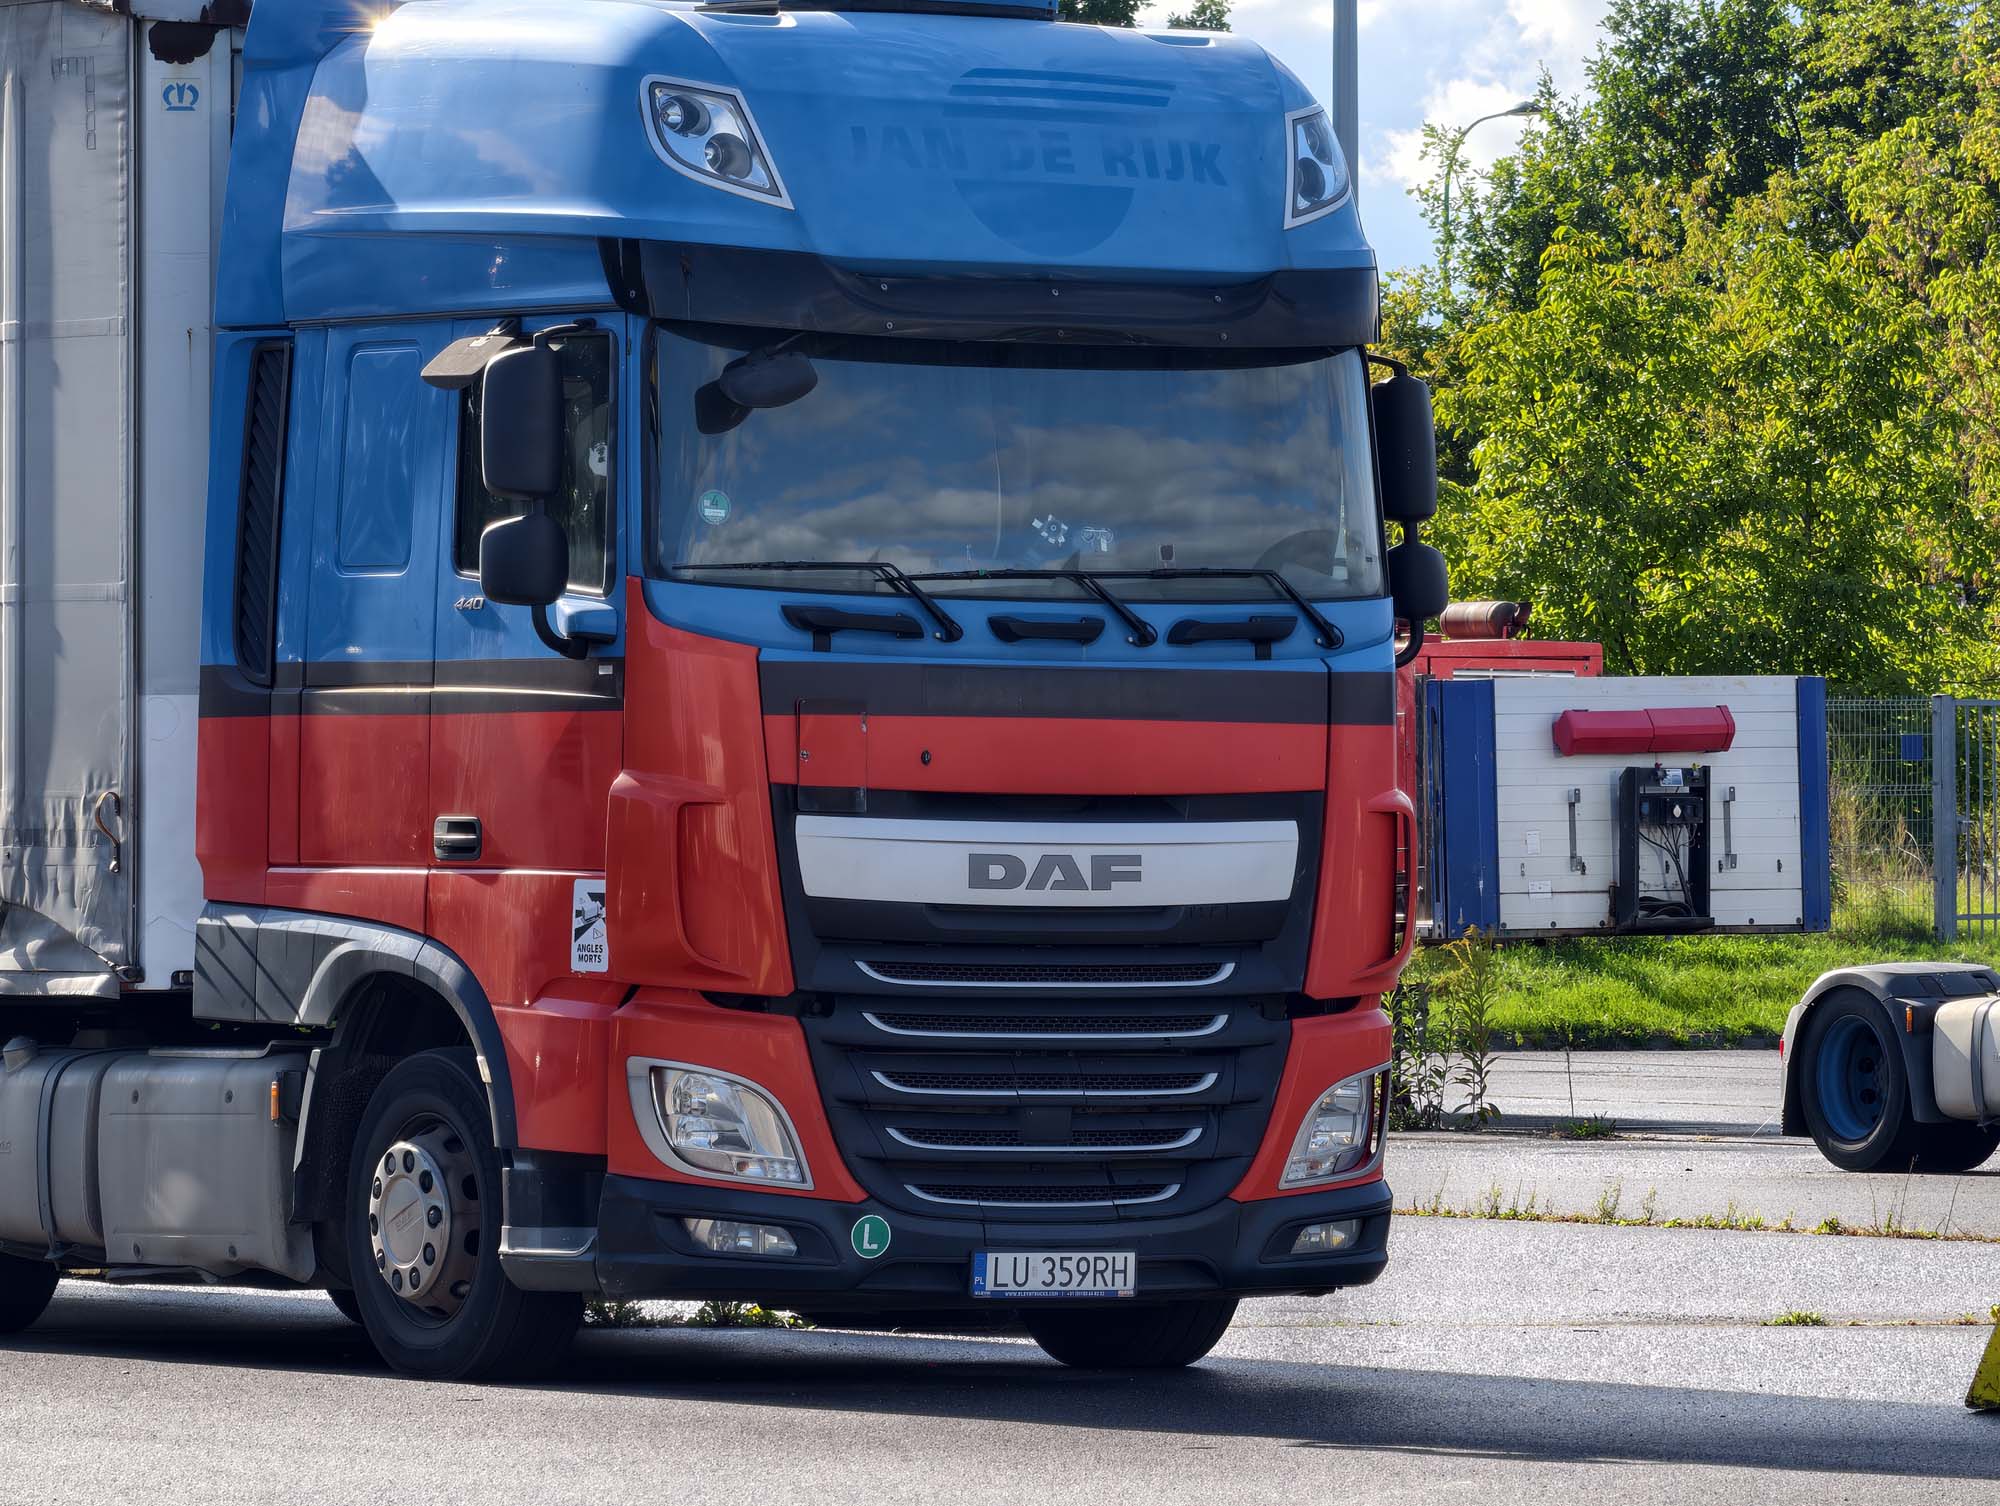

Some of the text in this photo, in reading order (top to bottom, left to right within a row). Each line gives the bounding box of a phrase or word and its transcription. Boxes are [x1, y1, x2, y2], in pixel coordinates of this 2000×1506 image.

[1000, 128, 1075, 174] DE
[1102, 135, 1228, 187] RIJK
[454, 597, 484, 610] 440
[968, 853, 1143, 892] DAF
[577, 943, 603, 954] ANGLES
[578, 954, 602, 963] MORTS
[863, 1223, 878, 1249] L
[993, 1256, 1128, 1287] LU 359RH
[974, 1277, 985, 1286] PL
